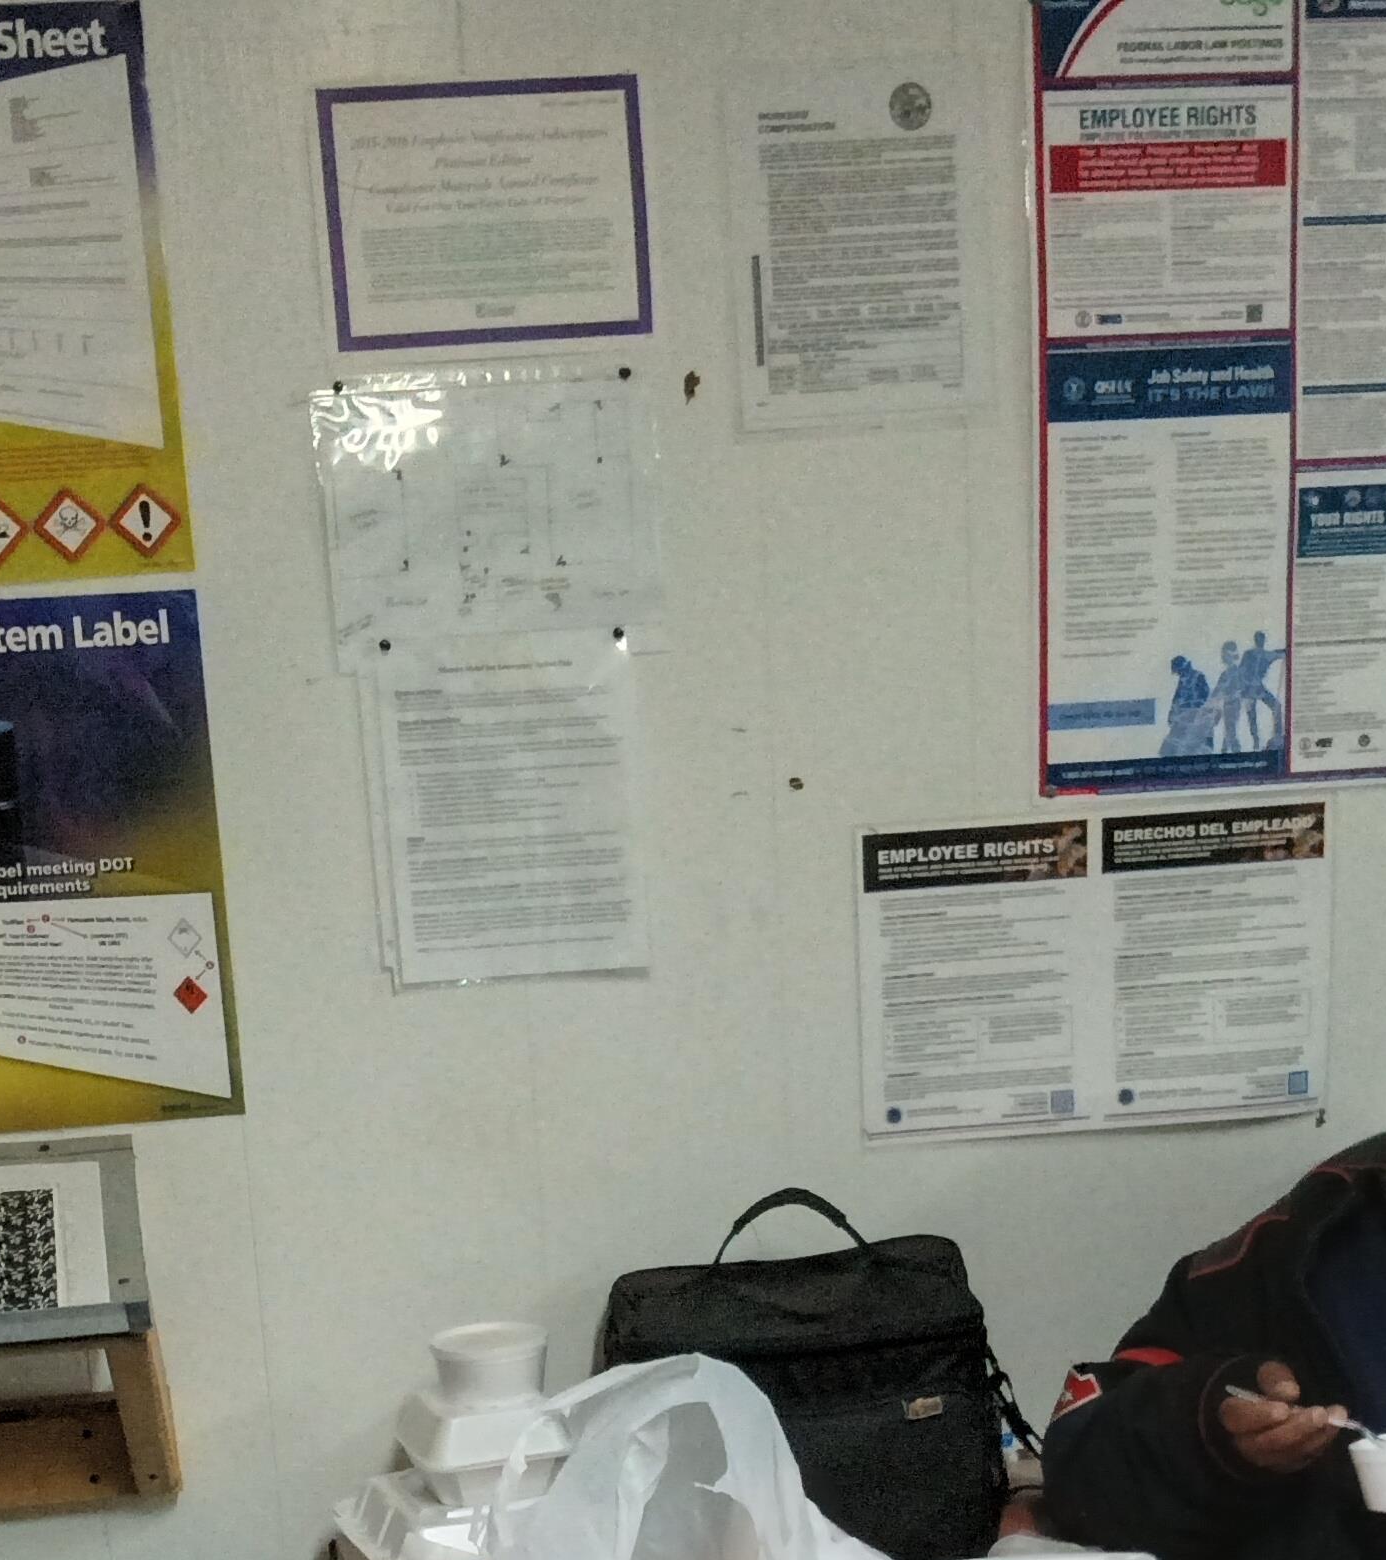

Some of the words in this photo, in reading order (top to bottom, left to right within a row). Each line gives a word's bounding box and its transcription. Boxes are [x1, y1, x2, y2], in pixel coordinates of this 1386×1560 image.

[1079, 107, 1180, 130] EMPLOYEE
[1187, 104, 1256, 127] RIGHTS
[1148, 369, 1171, 385] Job
[1173, 368, 1208, 385] Safety
[1211, 367, 1233, 381] and
[1235, 364, 1275, 380] Health
[1185, 385, 1220, 399] THE
[1311, 512, 1340, 527] YOUR
[74, 609, 170, 650] Label
[1113, 825, 1196, 842] DERECHOS
[1199, 822, 1228, 836] DEL
[1232, 814, 1315, 834] EMPLEADO
[878, 843, 979, 865] EMPLOYEE
[983, 838, 1055, 858] RIGHTS
[26, 859, 95, 878] meeting
[100, 857, 134, 873] DOT
